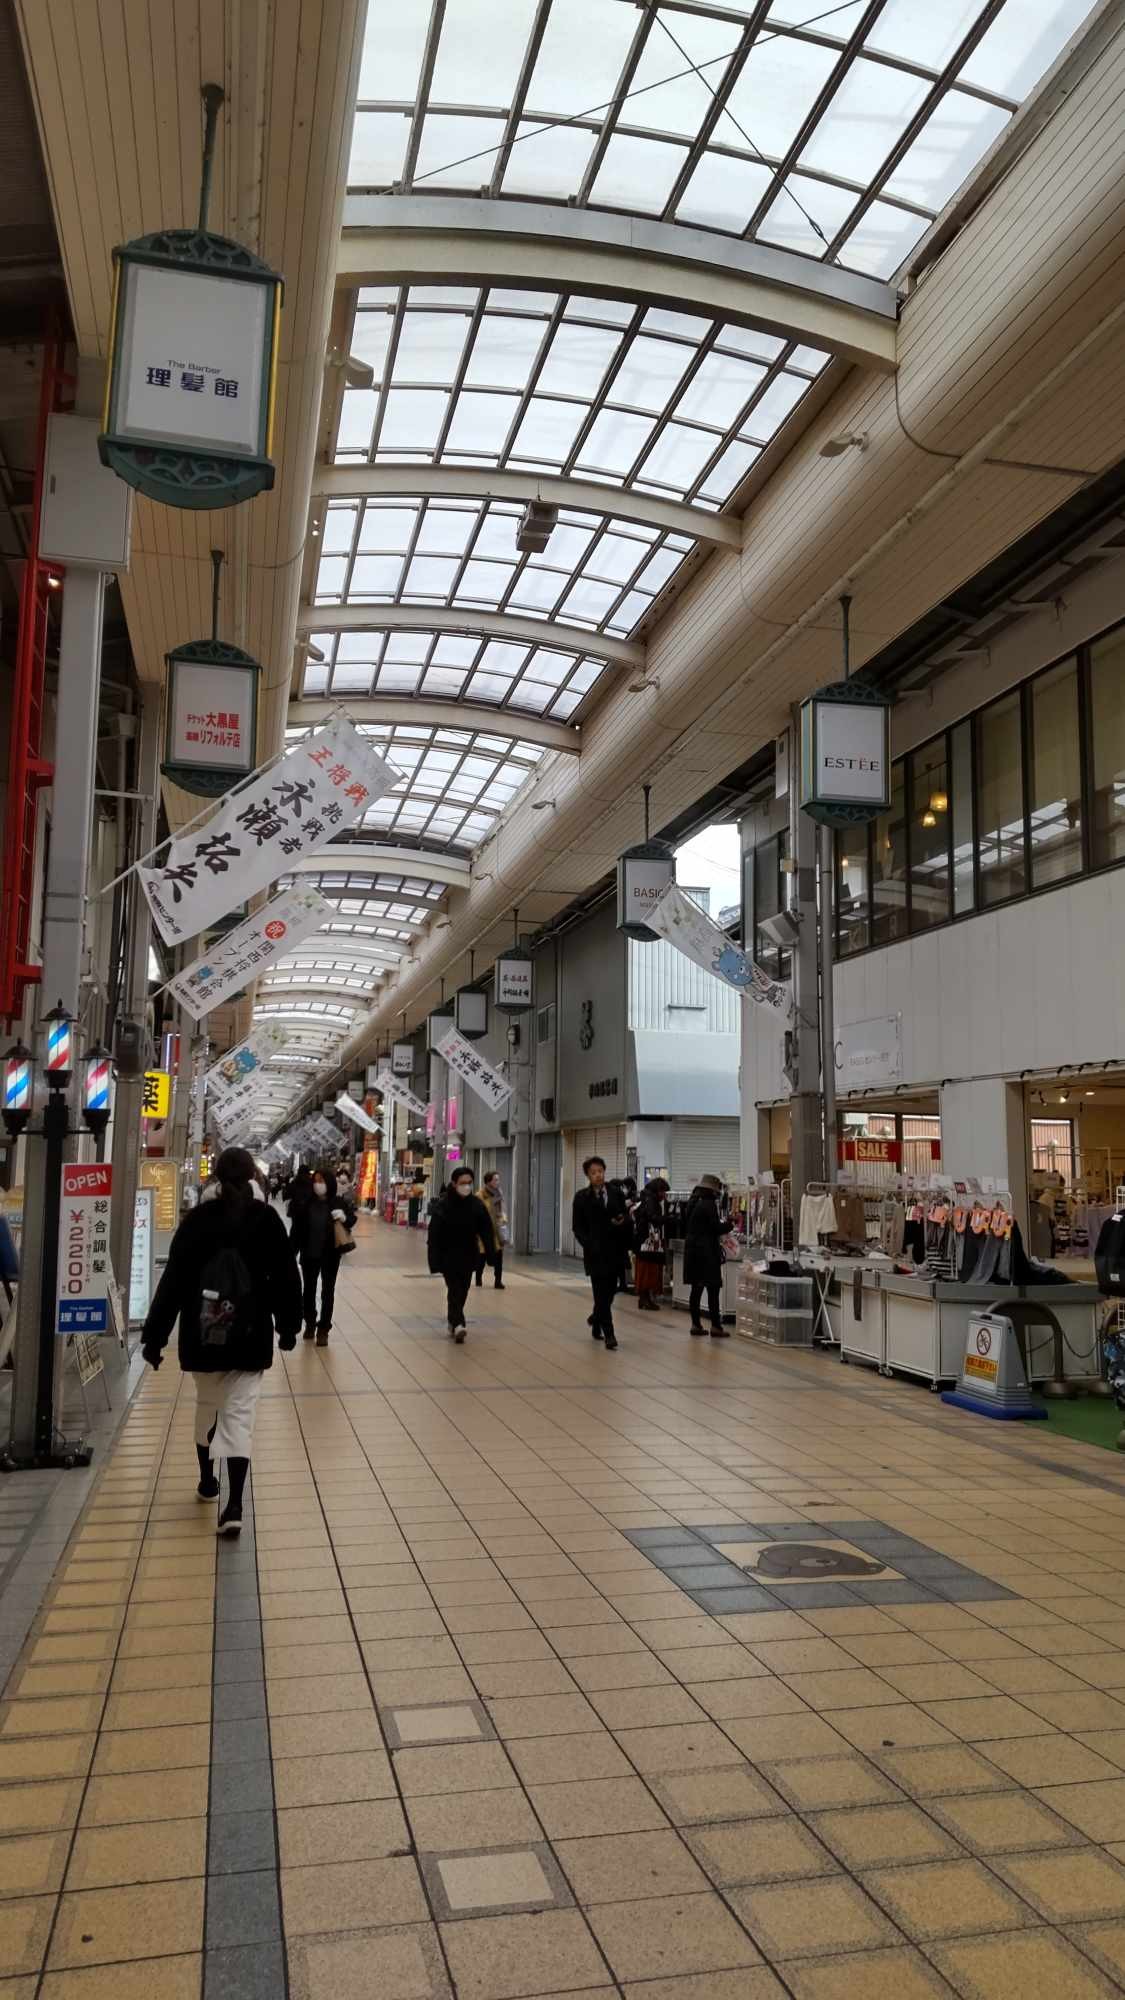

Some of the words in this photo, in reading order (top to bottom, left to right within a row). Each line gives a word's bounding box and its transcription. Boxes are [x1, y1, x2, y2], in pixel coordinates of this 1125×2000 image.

[308, 746, 370, 807] 王将戦
[278, 801, 346, 855] 挑戦者
[858, 1141, 889, 1158] SALE
[65, 1169, 108, 1192] OPEN
[67, 1208, 85, 1295] ¥2200
